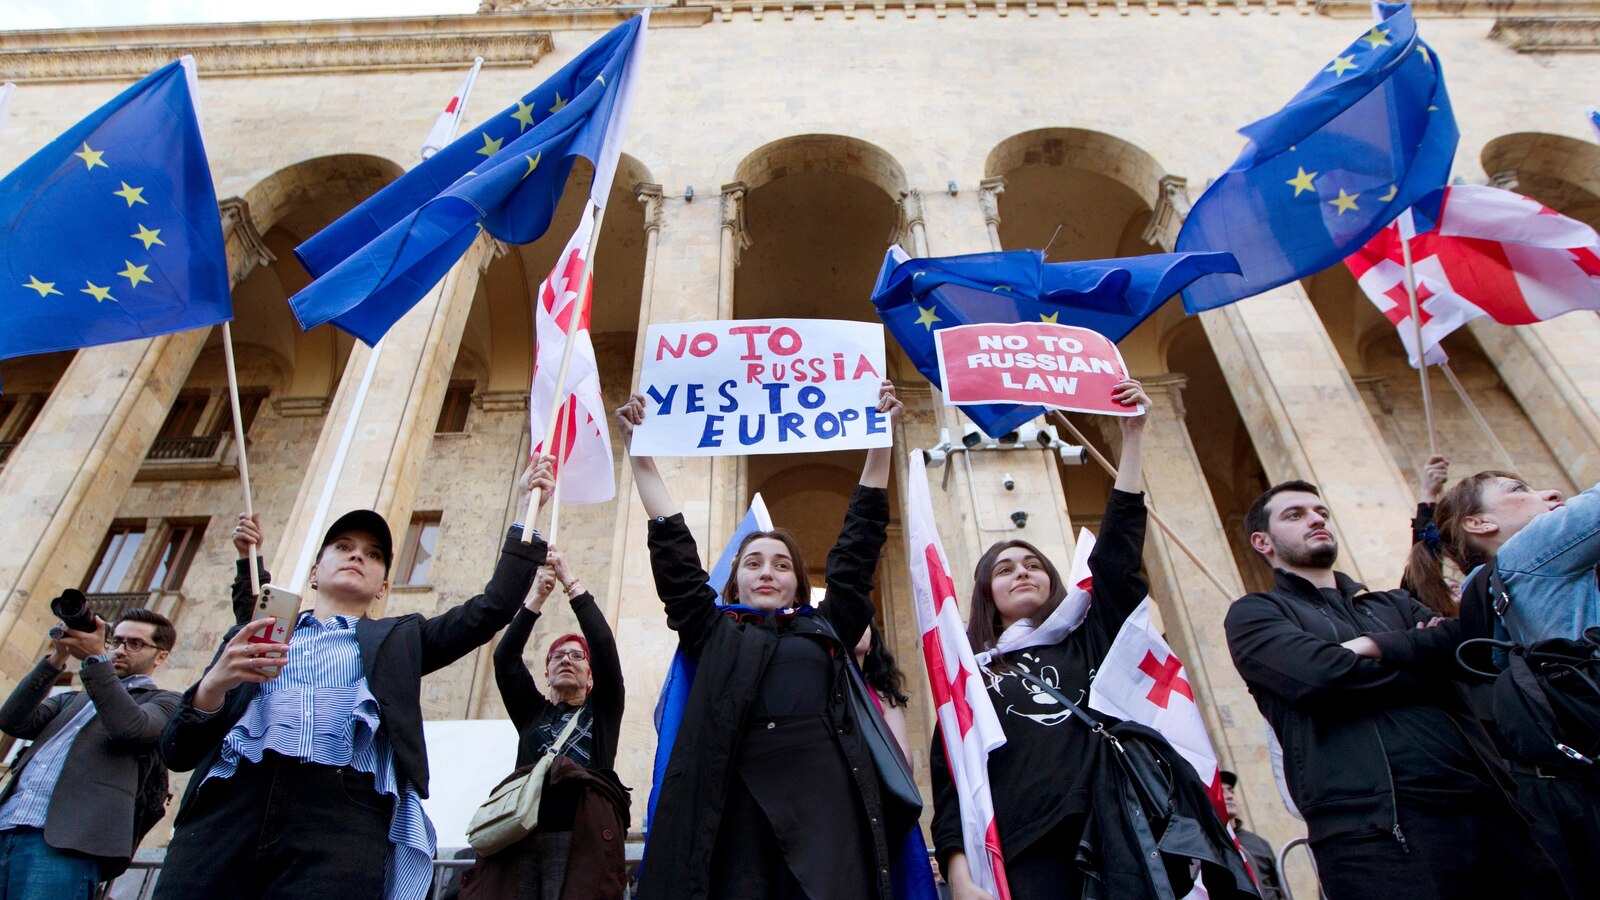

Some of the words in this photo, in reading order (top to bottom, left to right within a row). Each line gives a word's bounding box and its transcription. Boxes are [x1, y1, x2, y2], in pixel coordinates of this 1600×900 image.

[655, 332, 718, 361] NO
[729, 325, 803, 360] TO
[978, 335, 1028, 350] NO
[1036, 335, 1083, 354] TO
[967, 352, 1114, 375] RUSSIAN
[646, 379, 739, 415] YES
[762, 382, 826, 415] TO
[1001, 372, 1078, 395] LAW
[697, 406, 887, 448] EUROPE
